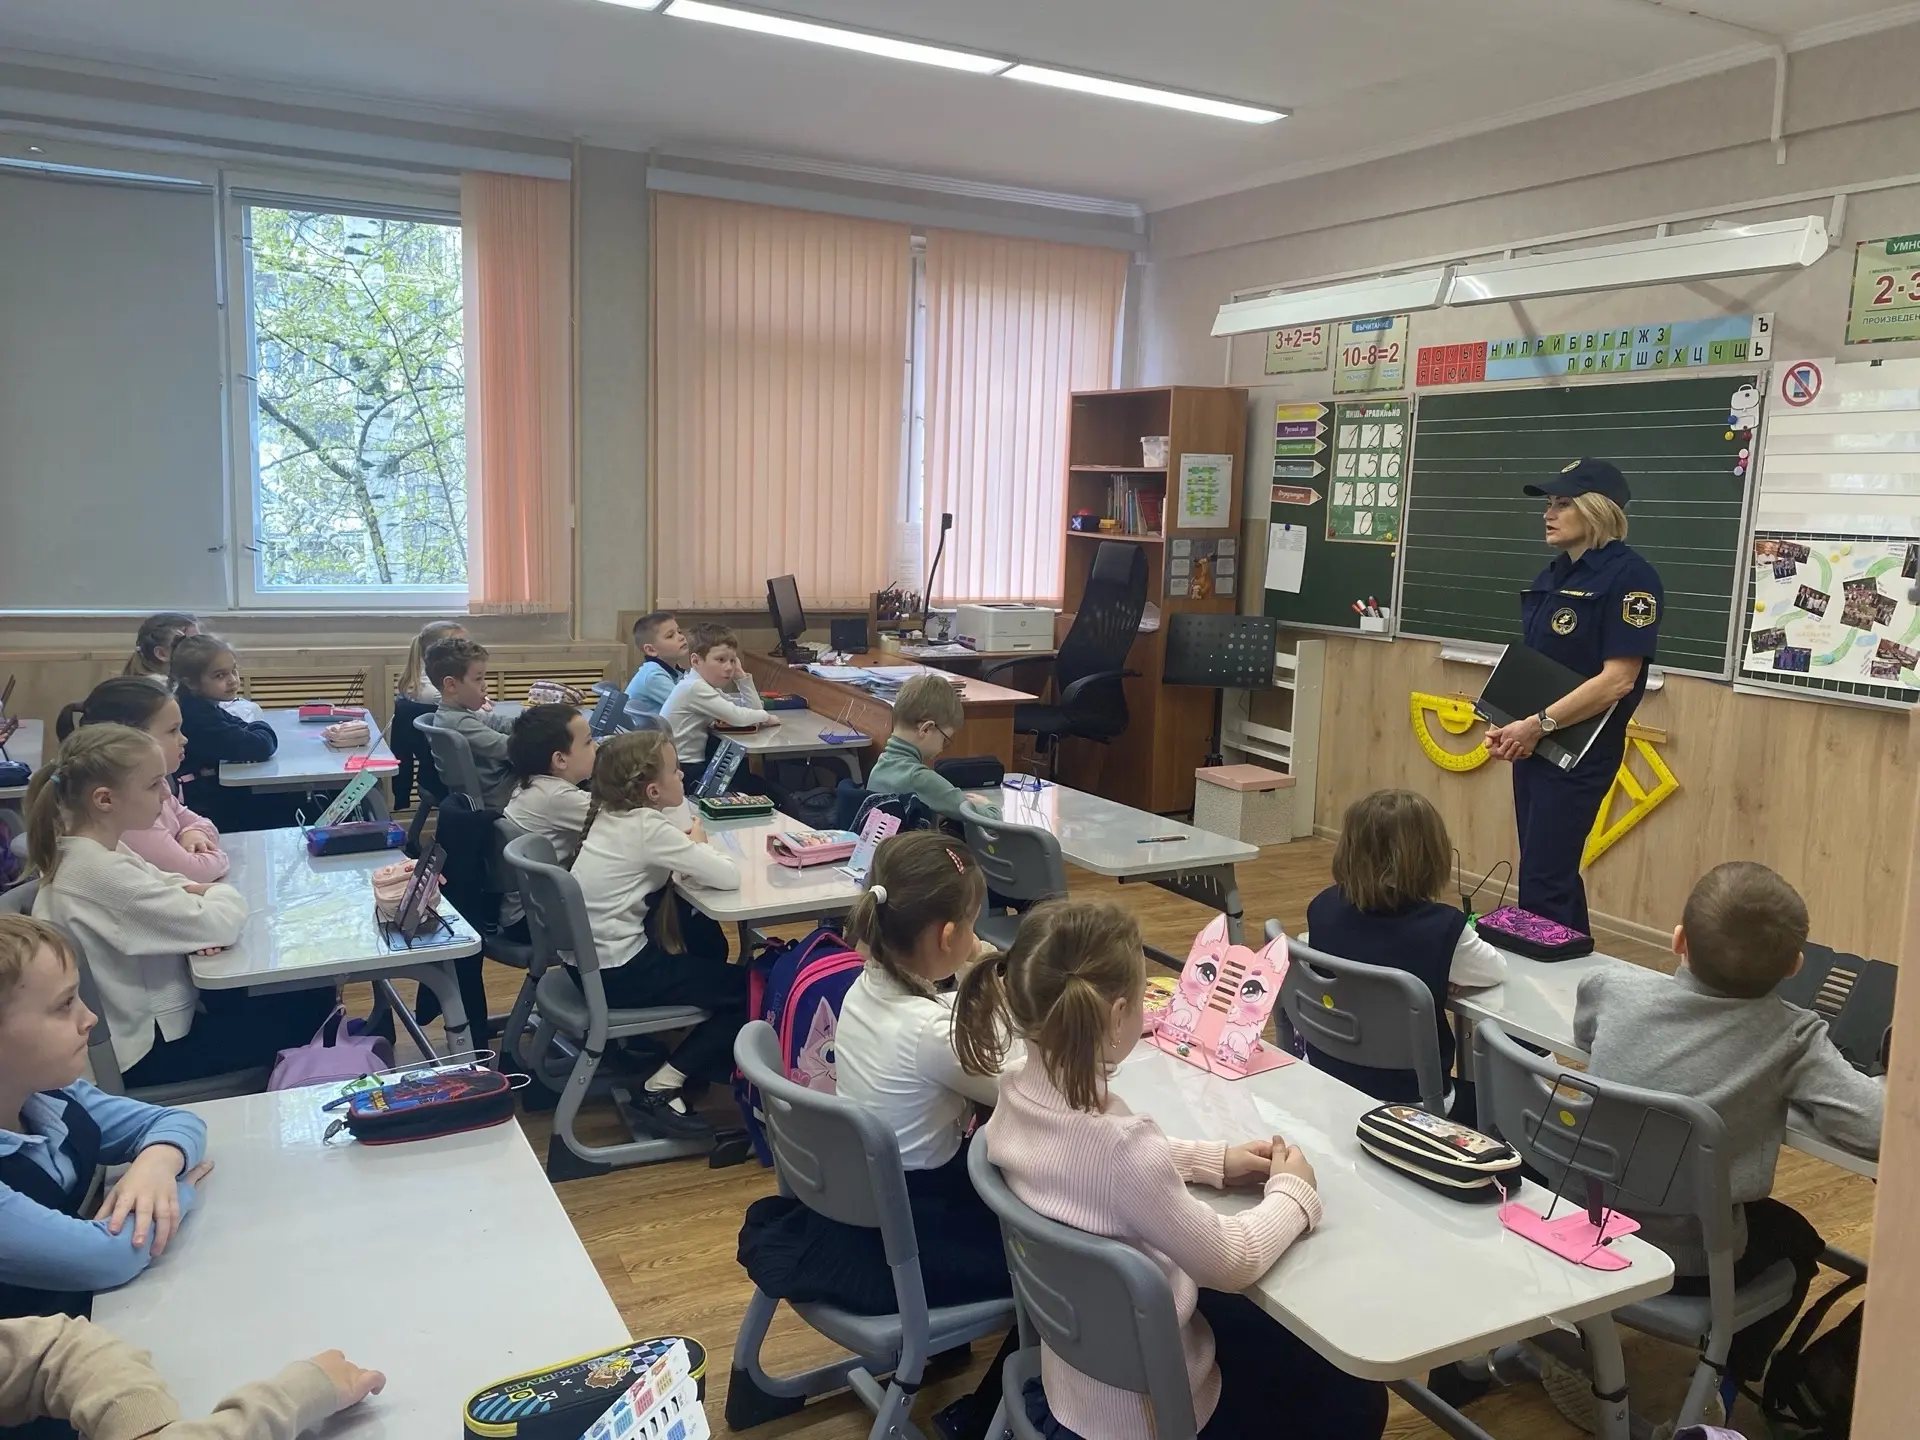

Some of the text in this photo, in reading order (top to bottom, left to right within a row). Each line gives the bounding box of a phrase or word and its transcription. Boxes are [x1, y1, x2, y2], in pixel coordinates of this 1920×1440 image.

[1758, 317, 1768, 333] Ъ
[1863, 313, 1920, 324] ПРОИЗВЕДЕН
[1275, 326, 1321, 350] 3+2=5
[1491, 327, 1664, 357] Н М Л Р Й Б В Г Д Ж З
[1755, 341, 1764, 356] Ь
[1342, 342, 1399, 367] 10-8=2
[1567, 343, 1746, 370] П Ф К Т Ш С Х Ц Ч Щ
[1348, 423, 1404, 449] 1 2 3
[1345, 452, 1400, 478] 4 5 6
[1342, 482, 1398, 507] 7 8 9
[1359, 510, 1373, 536] 0
